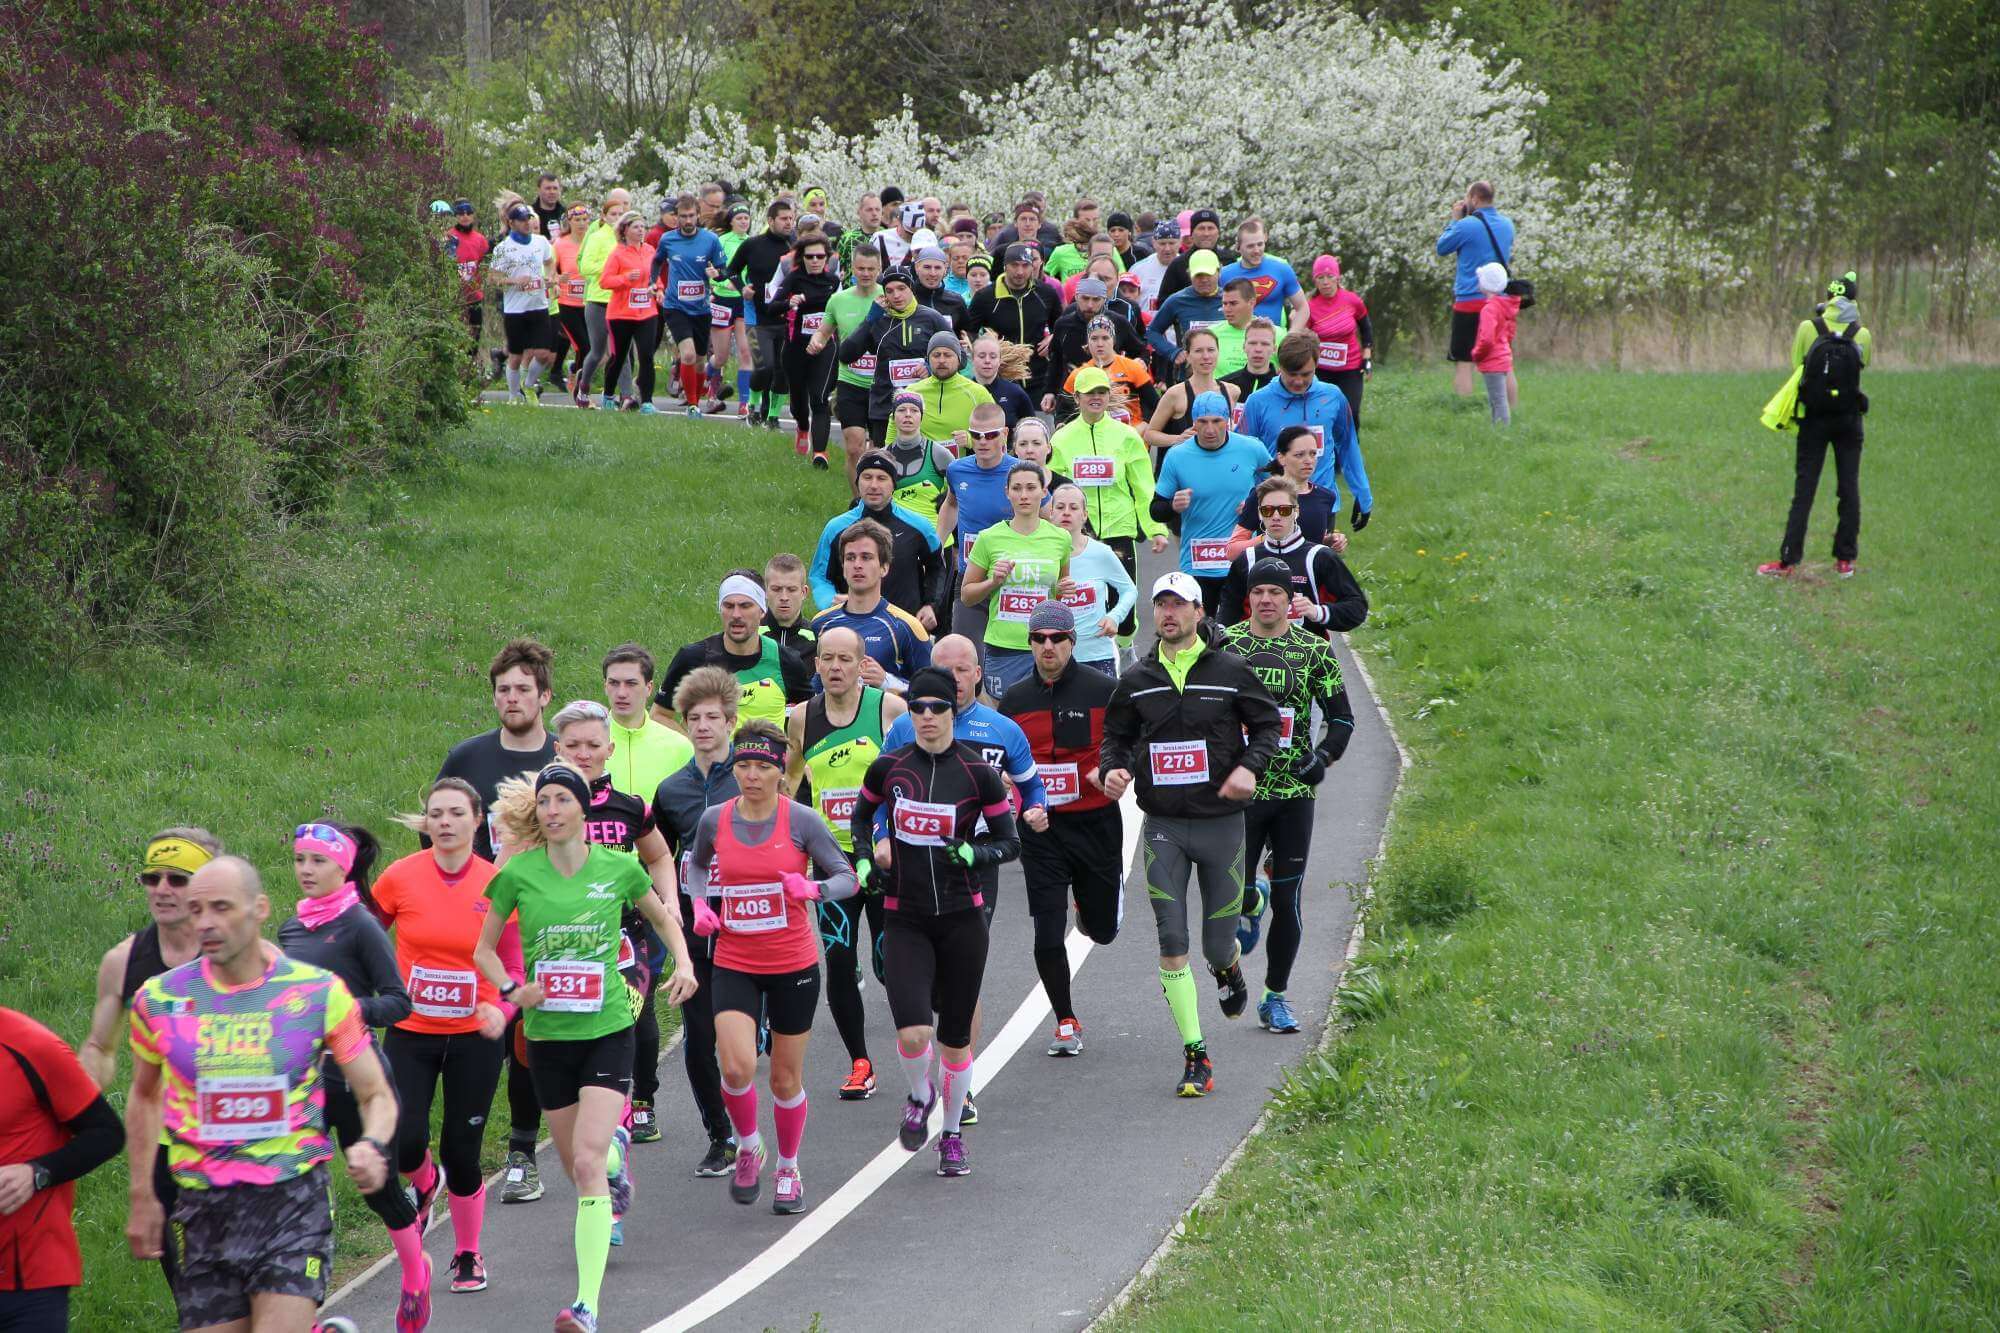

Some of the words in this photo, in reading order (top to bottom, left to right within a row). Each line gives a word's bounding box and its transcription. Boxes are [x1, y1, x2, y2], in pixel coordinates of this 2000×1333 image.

[1320, 349, 1340, 360] 400
[1080, 463, 1107, 476] 289
[1199, 547, 1227, 560] 464
[1009, 596, 1038, 610] 263
[1284, 650, 1305, 660] SWEEP
[1253, 666, 1287, 687] EZCI
[1163, 753, 1196, 770] 278
[585, 821, 628, 844] EEP
[904, 815, 941, 833] 473
[734, 898, 772, 916] 408
[549, 975, 588, 994] 331
[420, 985, 462, 1003] 484
[196, 1019, 274, 1057] SWEEP
[216, 1096, 272, 1120] 399
